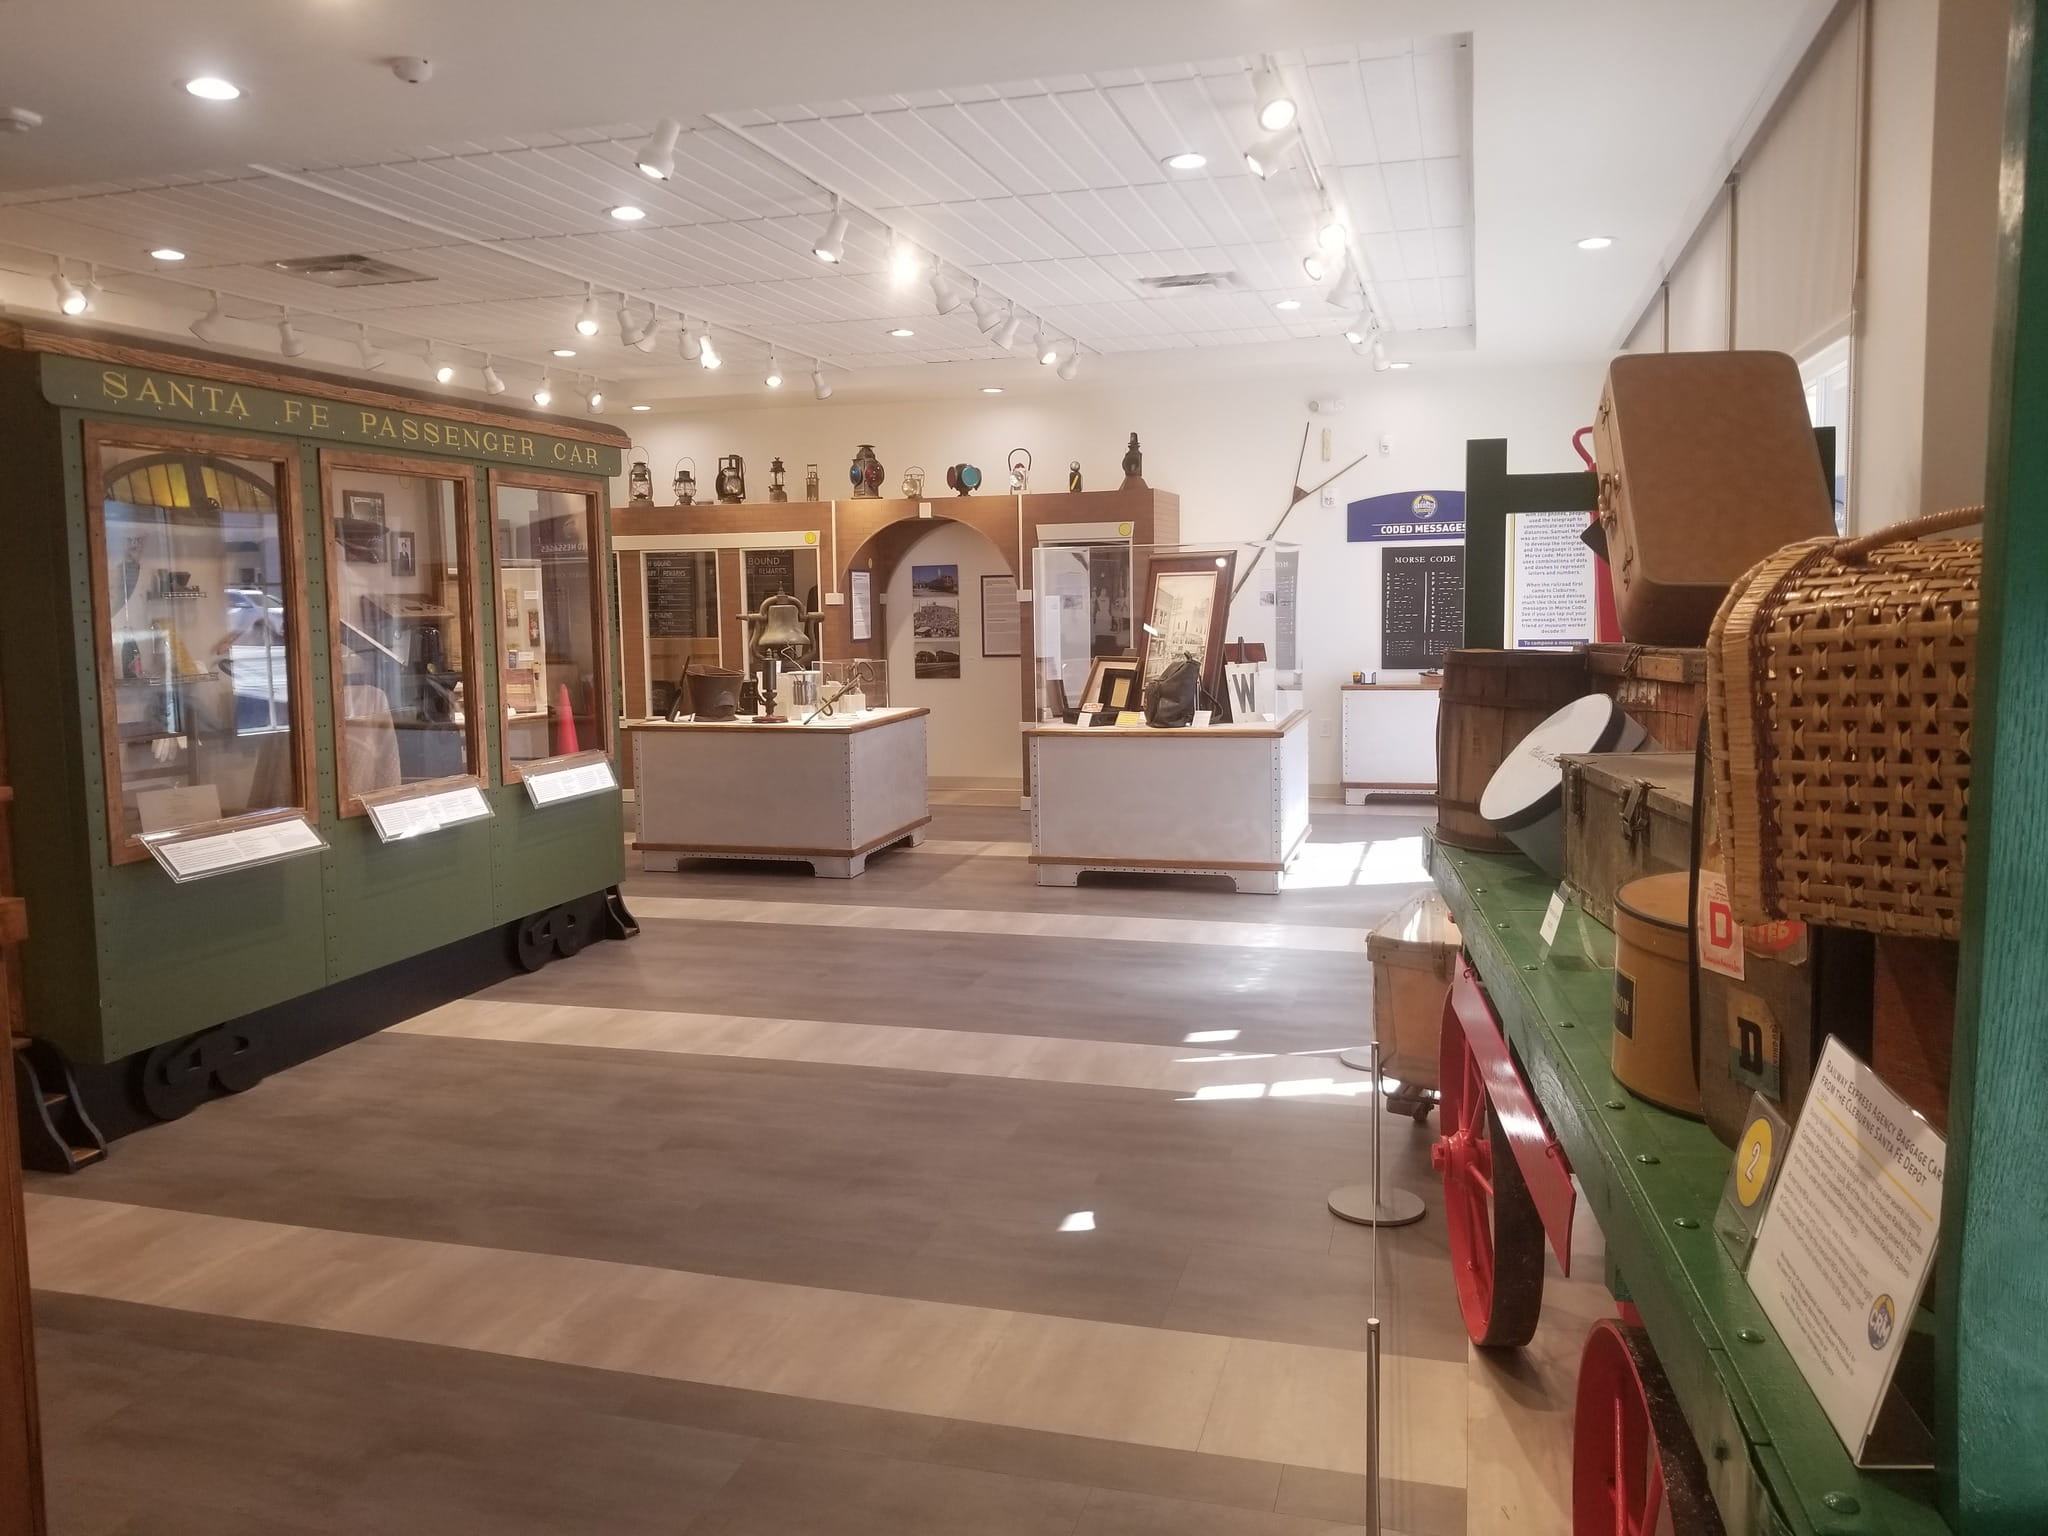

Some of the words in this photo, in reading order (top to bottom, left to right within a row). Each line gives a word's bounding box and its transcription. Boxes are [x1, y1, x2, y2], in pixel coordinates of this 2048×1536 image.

[102, 370, 248, 419] SANTA
[284, 400, 330, 429] FE
[361, 413, 535, 458] PASSENGER
[553, 442, 600, 467] CAR
[1381, 526, 1412, 534] CODED
[747, 557, 780, 565] BOUND
[1232, 672, 1256, 713] W
[1710, 901, 1732, 950] D
[1737, 1016, 1763, 1076] D
[1819, 1073, 1836, 1096] FROM
[1834, 1088, 1846, 1106] THE
[1744, 1140, 1762, 1184] 2
[1869, 1310, 1892, 1343] CRM
